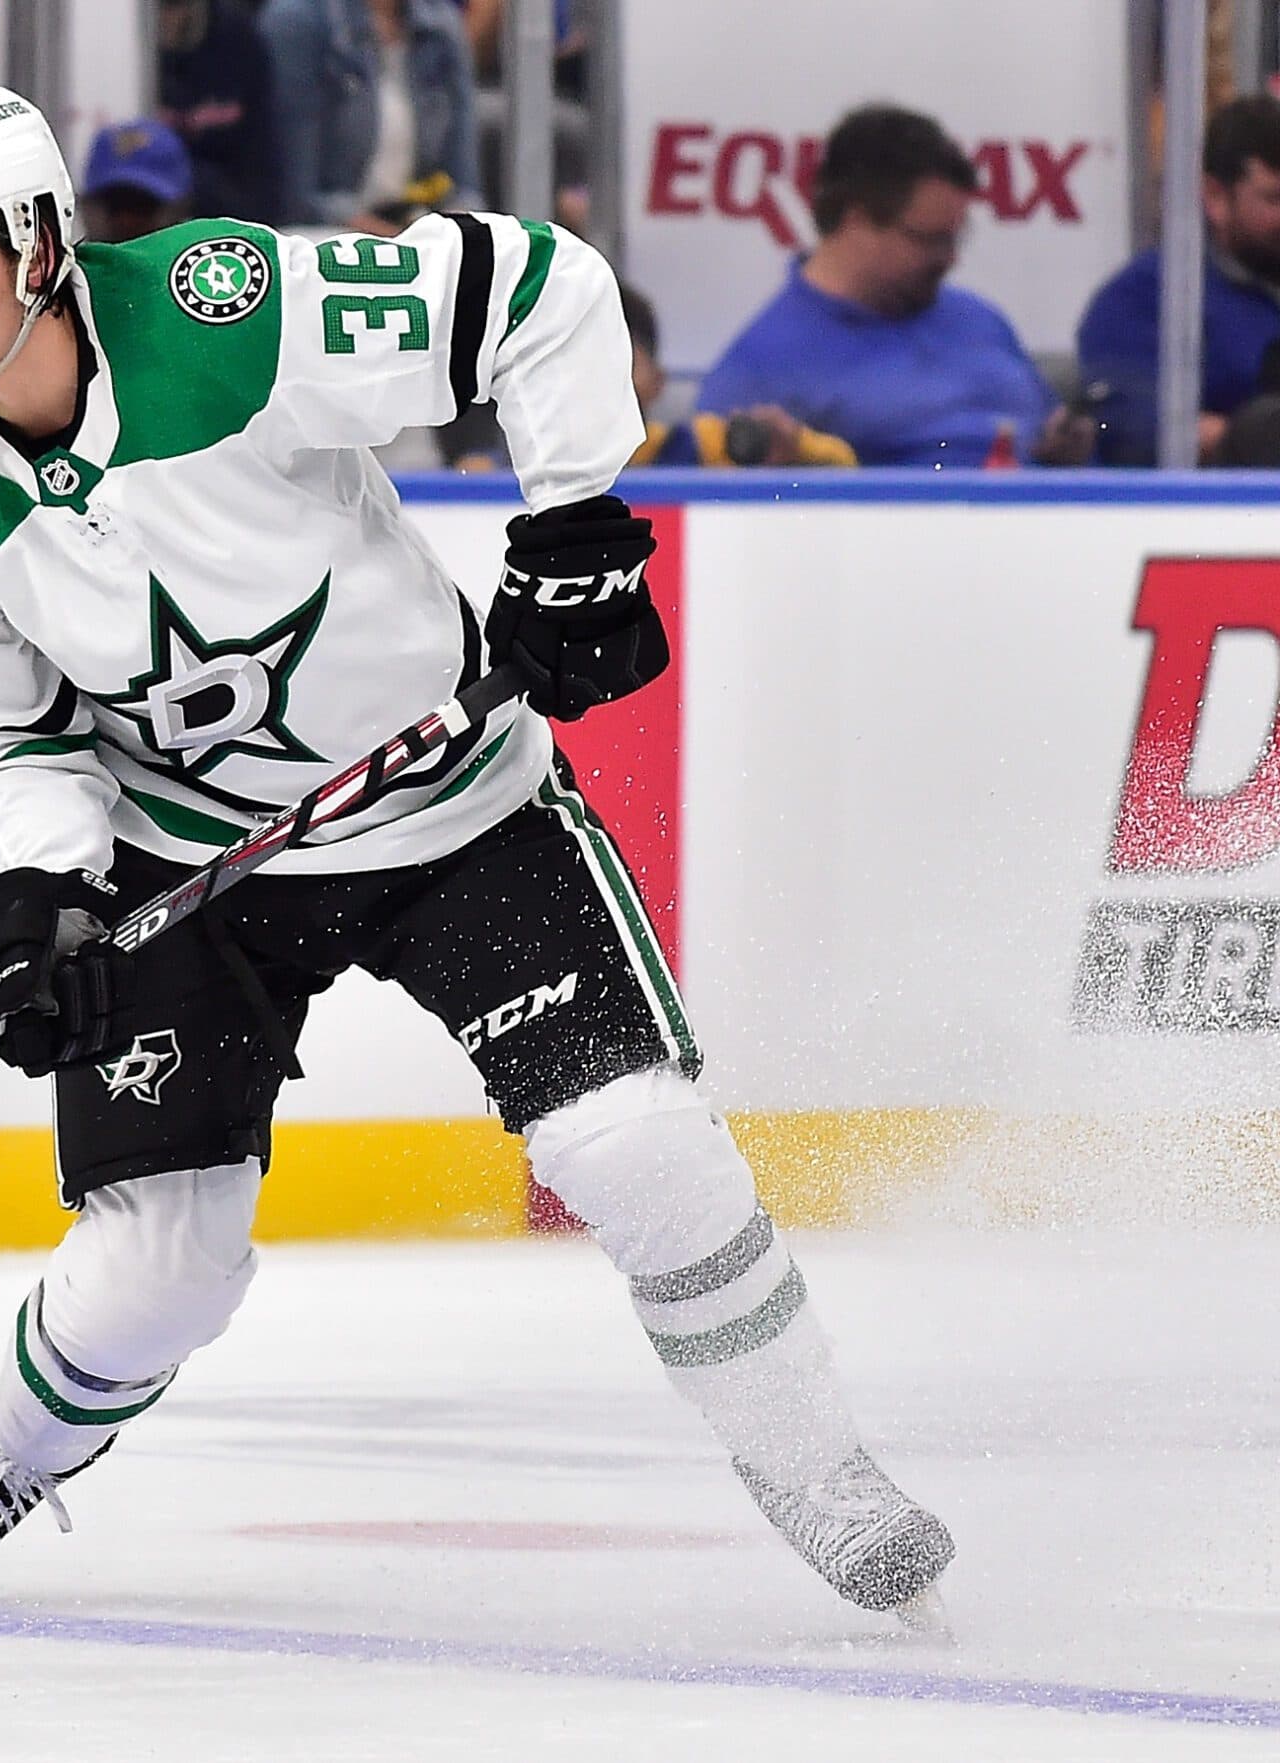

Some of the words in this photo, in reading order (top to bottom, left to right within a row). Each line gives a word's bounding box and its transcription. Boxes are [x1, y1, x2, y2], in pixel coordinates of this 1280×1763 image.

[646, 123, 1090, 249] EQAX
[317, 238, 431, 354] 36
[500, 558, 648, 607] CCM
[1114, 924, 1280, 1013] TIR
[457, 972, 579, 1056] CCM
